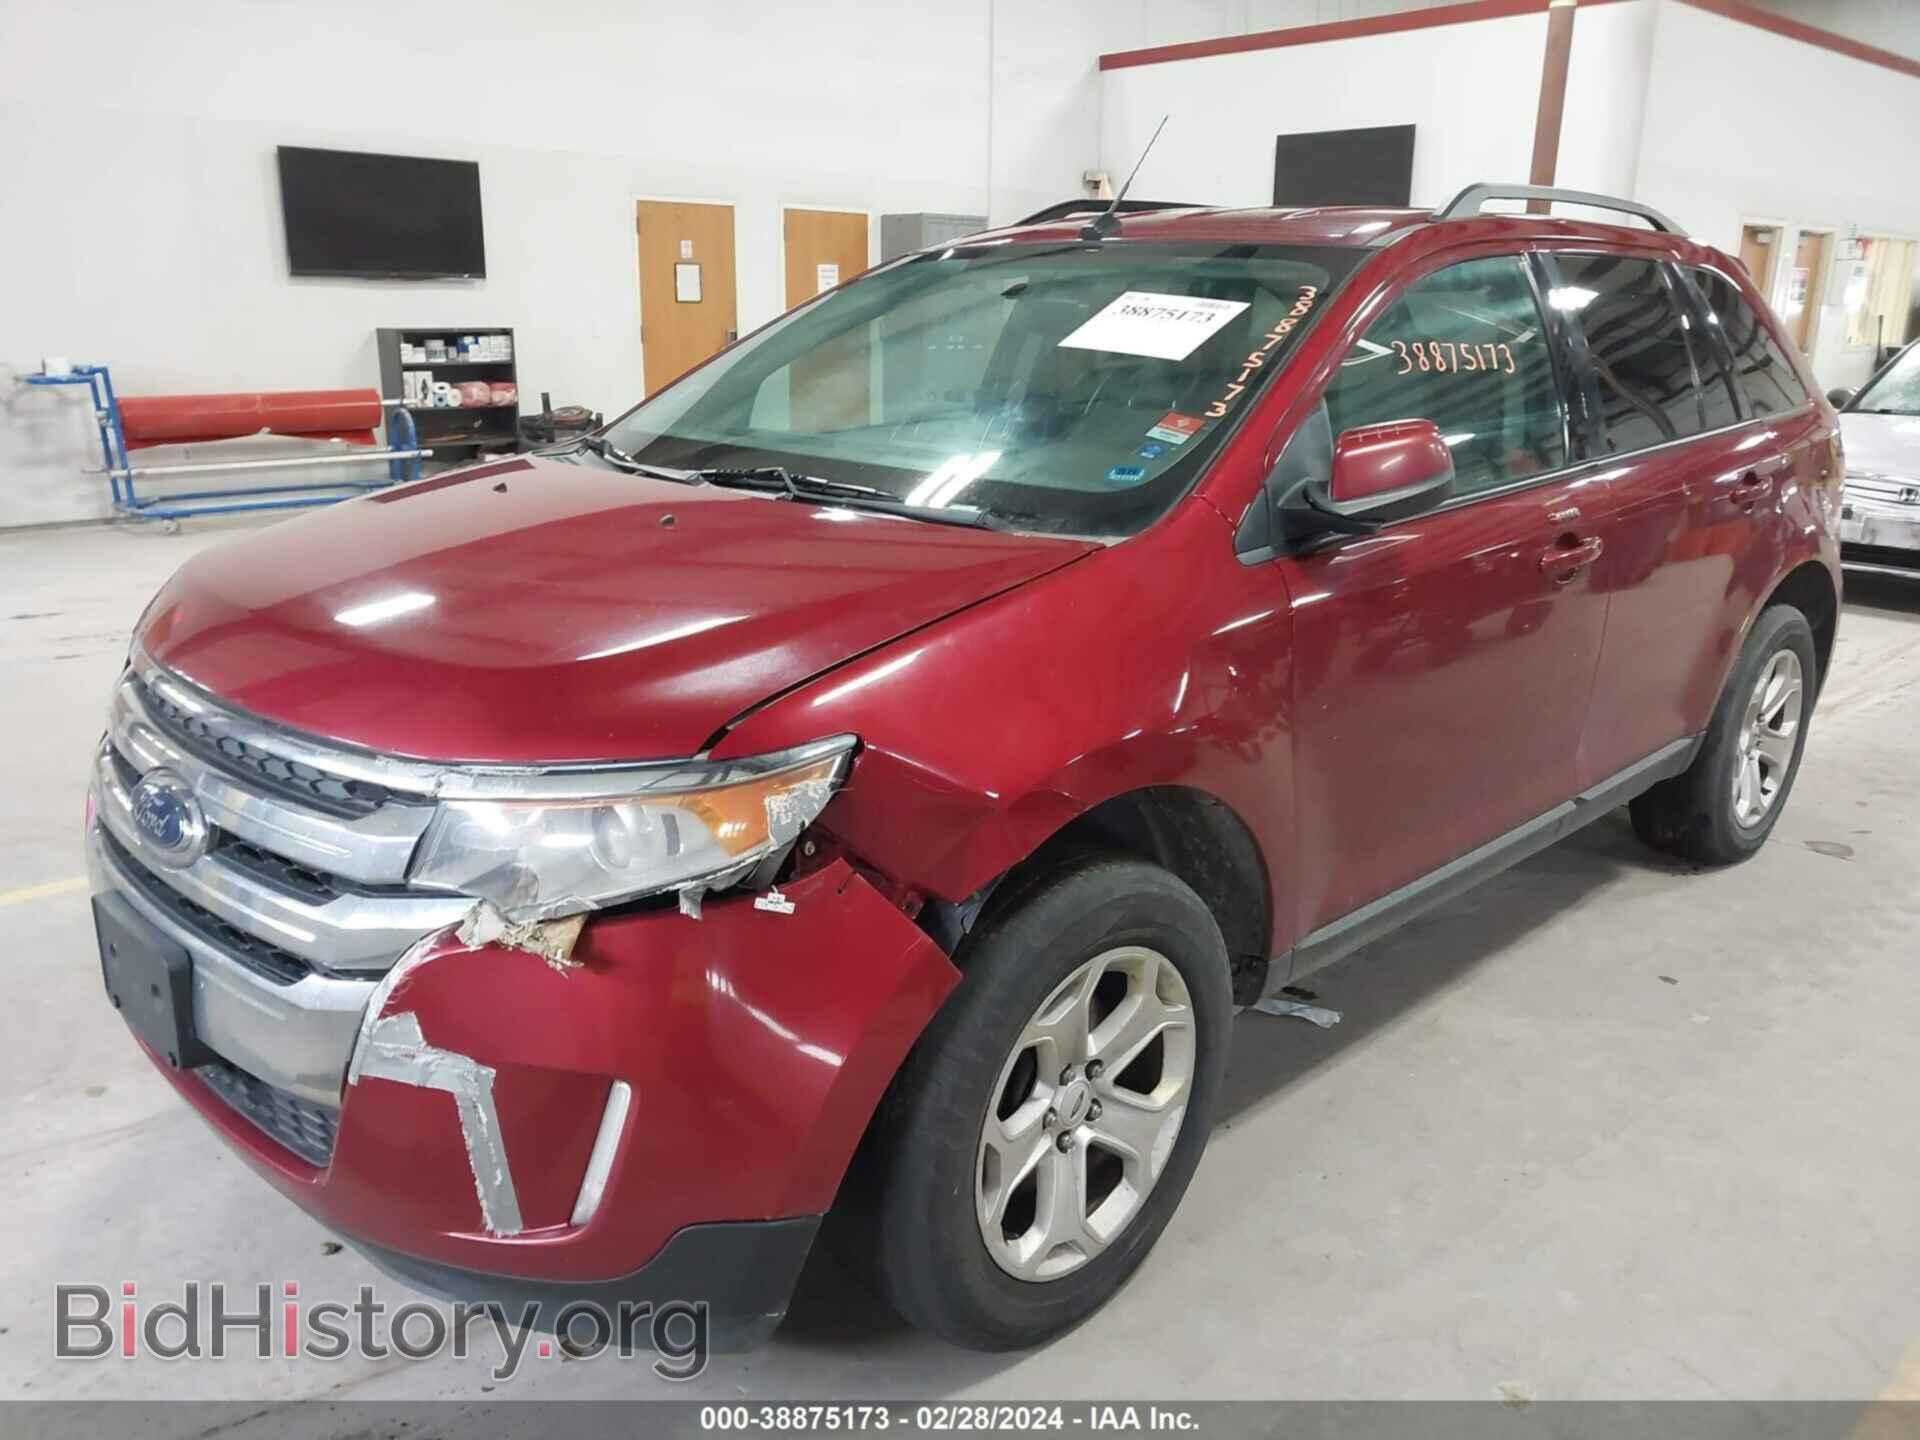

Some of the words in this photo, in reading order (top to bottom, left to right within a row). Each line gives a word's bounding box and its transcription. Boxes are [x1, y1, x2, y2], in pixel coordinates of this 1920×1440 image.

[1112, 304, 1216, 324] 38875173
[1203, 286, 1317, 418] 38875173
[1391, 340, 1515, 375] 38875173
